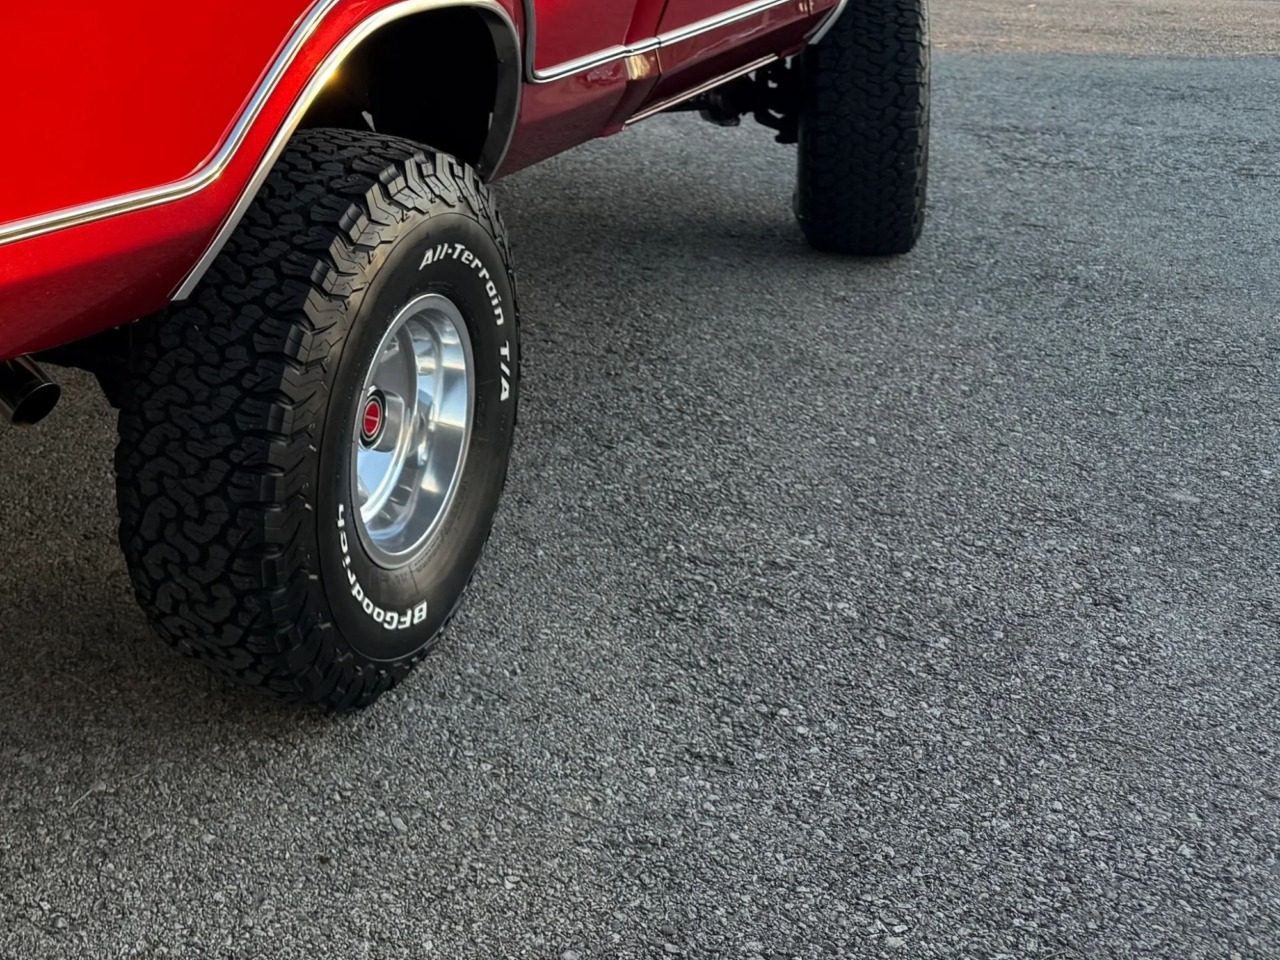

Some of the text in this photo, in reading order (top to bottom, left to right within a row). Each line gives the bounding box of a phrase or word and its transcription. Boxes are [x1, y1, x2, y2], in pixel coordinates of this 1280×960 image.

[418, 243, 511, 402] All-Terrain T/A
[336, 503, 428, 630] BFGoodrich
